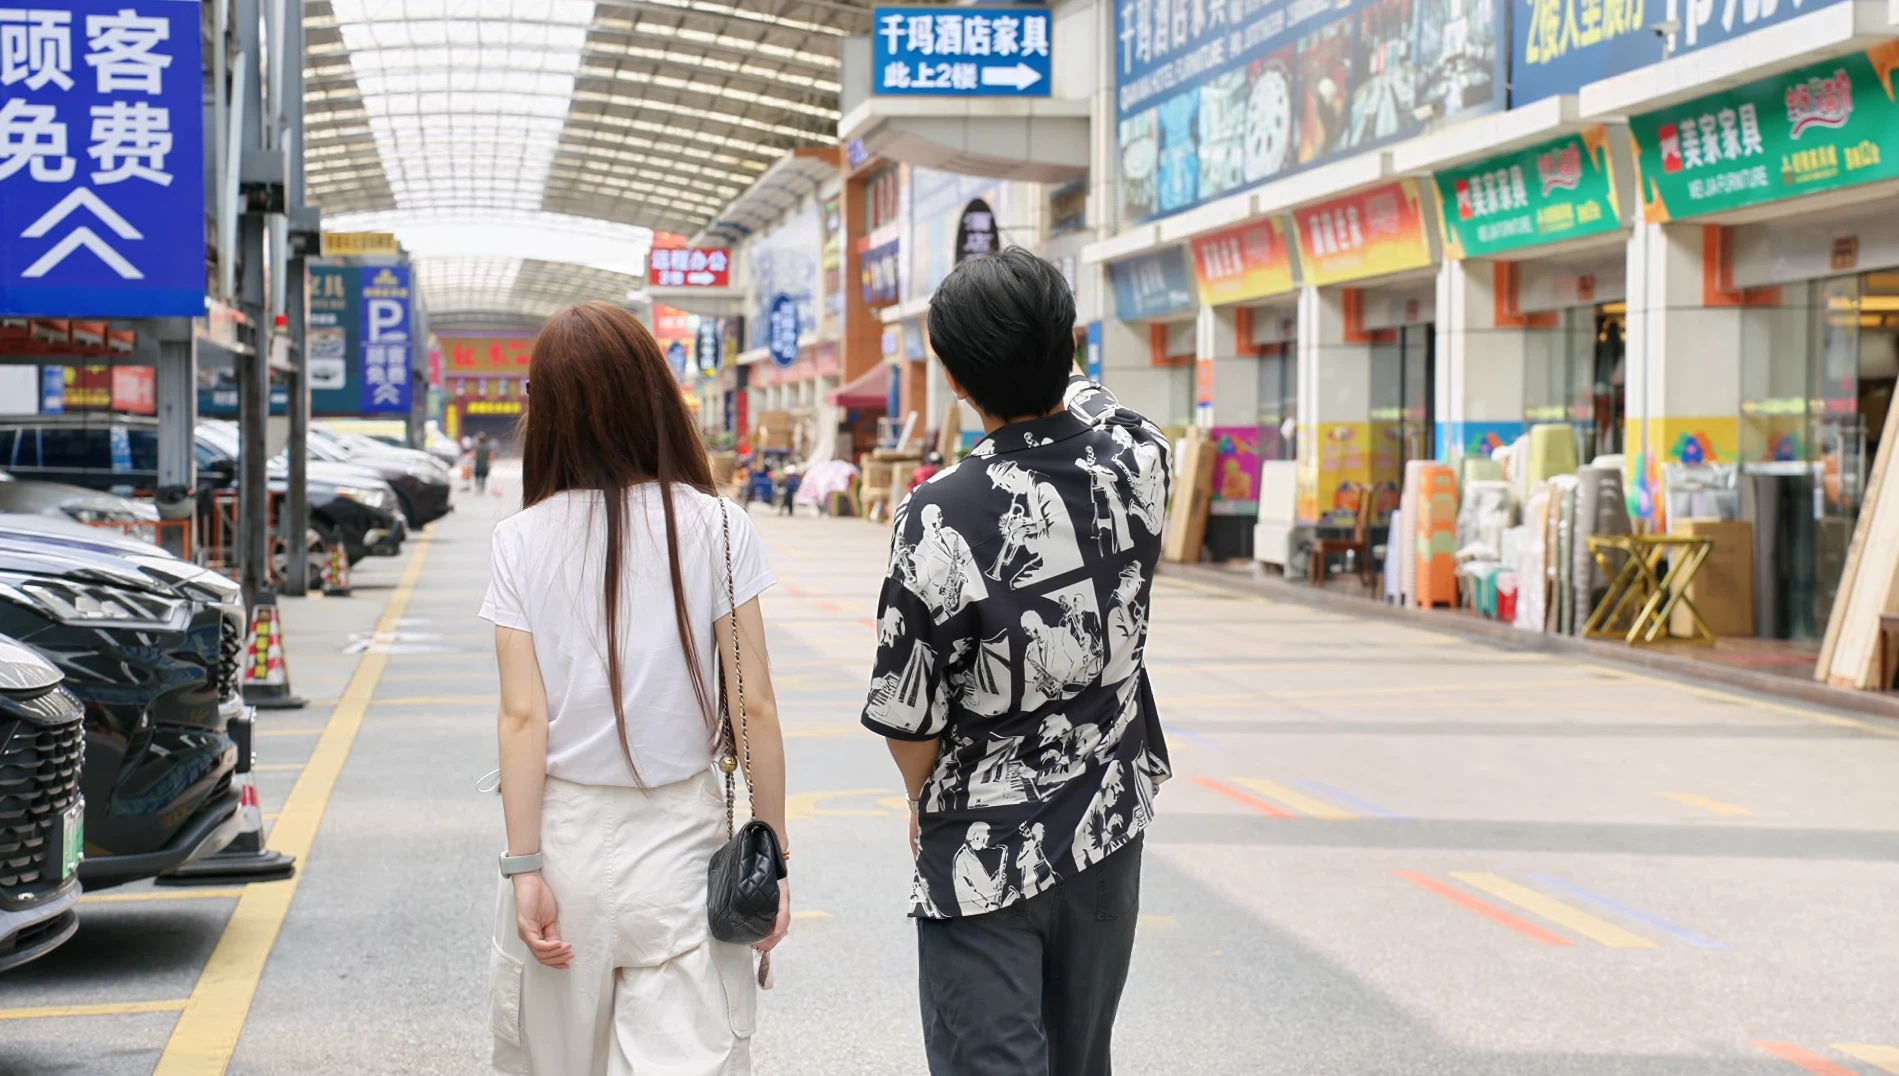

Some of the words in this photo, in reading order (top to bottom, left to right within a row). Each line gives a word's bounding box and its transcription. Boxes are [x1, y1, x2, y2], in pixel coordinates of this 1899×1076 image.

[0, 8, 174, 95] 顾客
[878, 14, 1049, 56] 千玛酒店家具
[883, 61, 978, 90] 此上2楼
[0, 98, 175, 187] 免费
[1680, 103, 1764, 170] 美家家具
[368, 299, 404, 344] P
